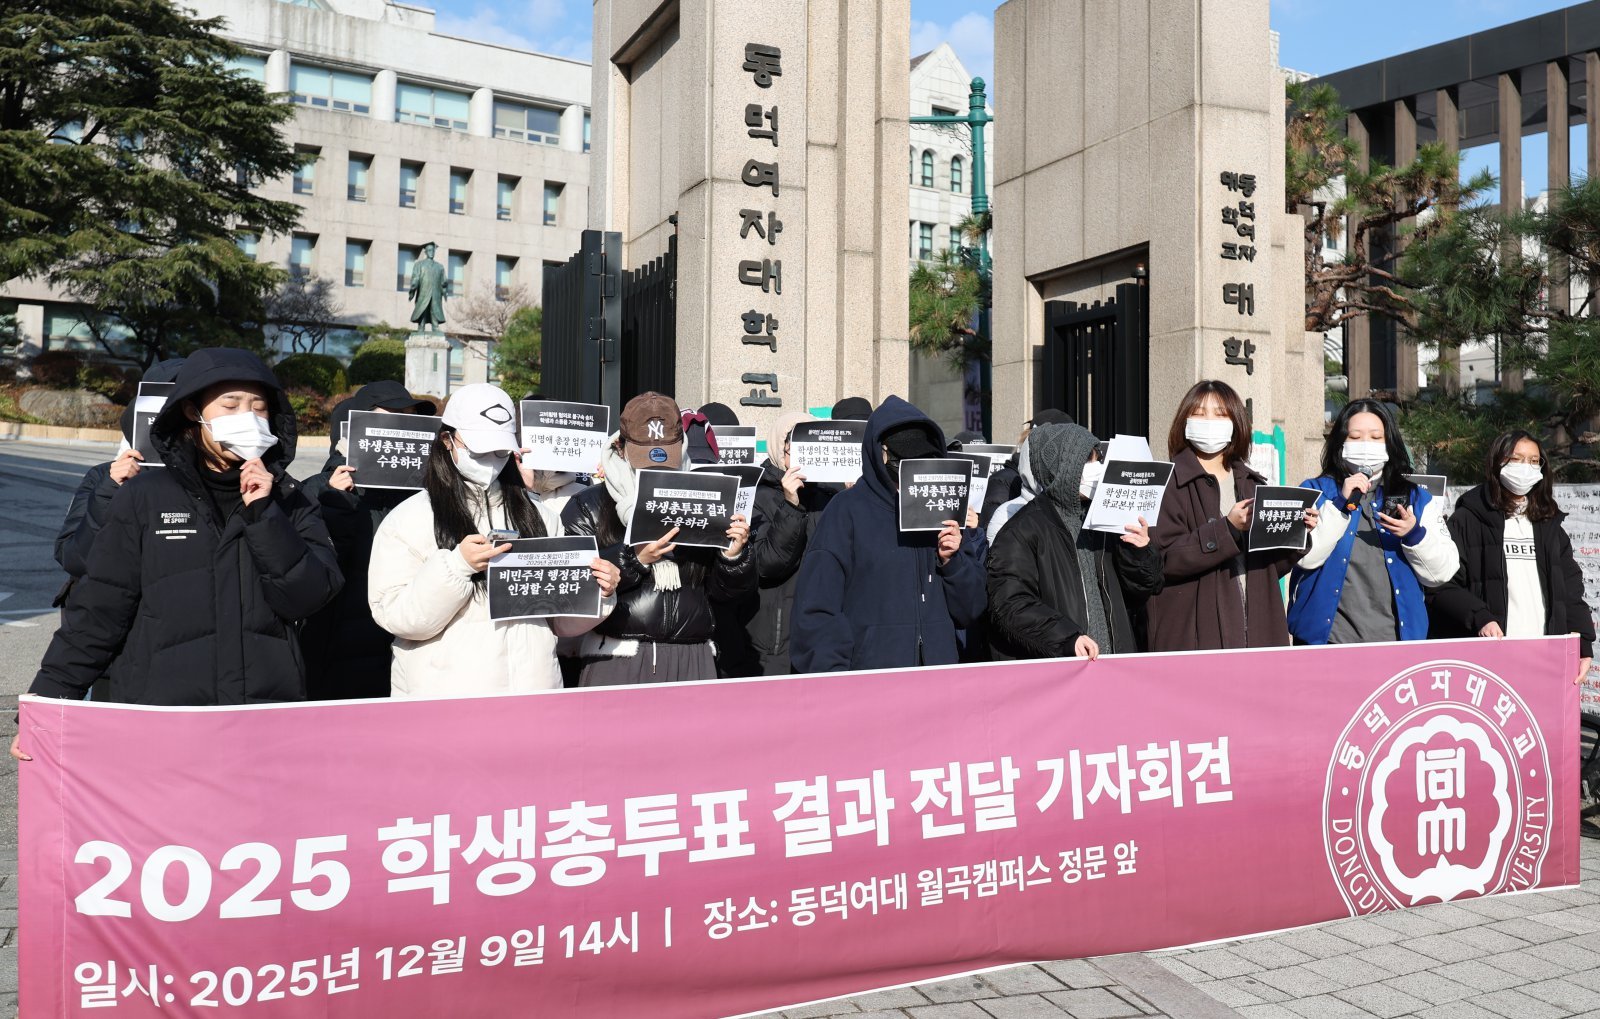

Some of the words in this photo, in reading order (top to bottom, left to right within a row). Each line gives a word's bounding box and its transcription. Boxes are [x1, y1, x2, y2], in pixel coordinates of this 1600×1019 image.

[1220, 171, 1239, 261] 대학교
[1236, 173, 1257, 263] 동덕여자
[738, 42, 783, 408] 동덕여자대학교
[1222, 282, 1257, 424] 대학
[647, 420, 665, 439] NY
[358, 438, 416, 455] 학생총투표
[419, 442, 432, 456] 결
[529, 434, 553, 445] 김명애
[555, 435, 570, 446] 총장
[572, 437, 587, 447] 엄격
[589, 439, 603, 448] 수사
[552, 445, 582, 457] 촉구한다
[798, 446, 829, 456] 학생의견
[832, 446, 862, 456] 묵살하는
[376, 455, 423, 470] 수용하라
[798, 456, 829, 467] 학교본부
[832, 457, 862, 467] 규탄한다
[908, 484, 957, 498] 학생총투표
[1106, 487, 1138, 500] 학생의견
[1139, 488, 1158, 500] 묵살하는
[645, 500, 703, 515] 학생총투표
[706, 502, 727, 518] 결과
[925, 498, 960, 511] 수용하라
[1102, 499, 1135, 511] 학교본부
[1136, 500, 1156, 511] 규탄한다
[660, 515, 709, 529] 수용하라
[1258, 509, 1293, 522] 학생총투표
[1265, 521, 1293, 533] 수용하라
[499, 569, 544, 583] 비민주적
[547, 568, 593, 582] 행정절차
[507, 582, 542, 596] 인정할
[544, 582, 556, 596] 수
[559, 582, 581, 595] 없다
[1338, 669, 1536, 770] 동덕여자대학교
[73, 833, 351, 923] 2025
[377, 788, 755, 906] 학생총투표
[772, 769, 896, 858] 결과
[910, 755, 1021, 840] 전달
[1036, 736, 1234, 821] 기자회견
[73, 960, 175, 1009] 일시:
[189, 946, 360, 1008] 2025년
[375, 935, 468, 981] 12월
[480, 924, 546, 967] 9일
[558, 909, 640, 960] 14시
[703, 896, 778, 940] 장소:
[788, 872, 908, 928] 동덕여대
[917, 857, 1052, 906] 월곡캠퍼스
[1058, 845, 1108, 886] 정문
[1113, 838, 1140, 875] 앞
